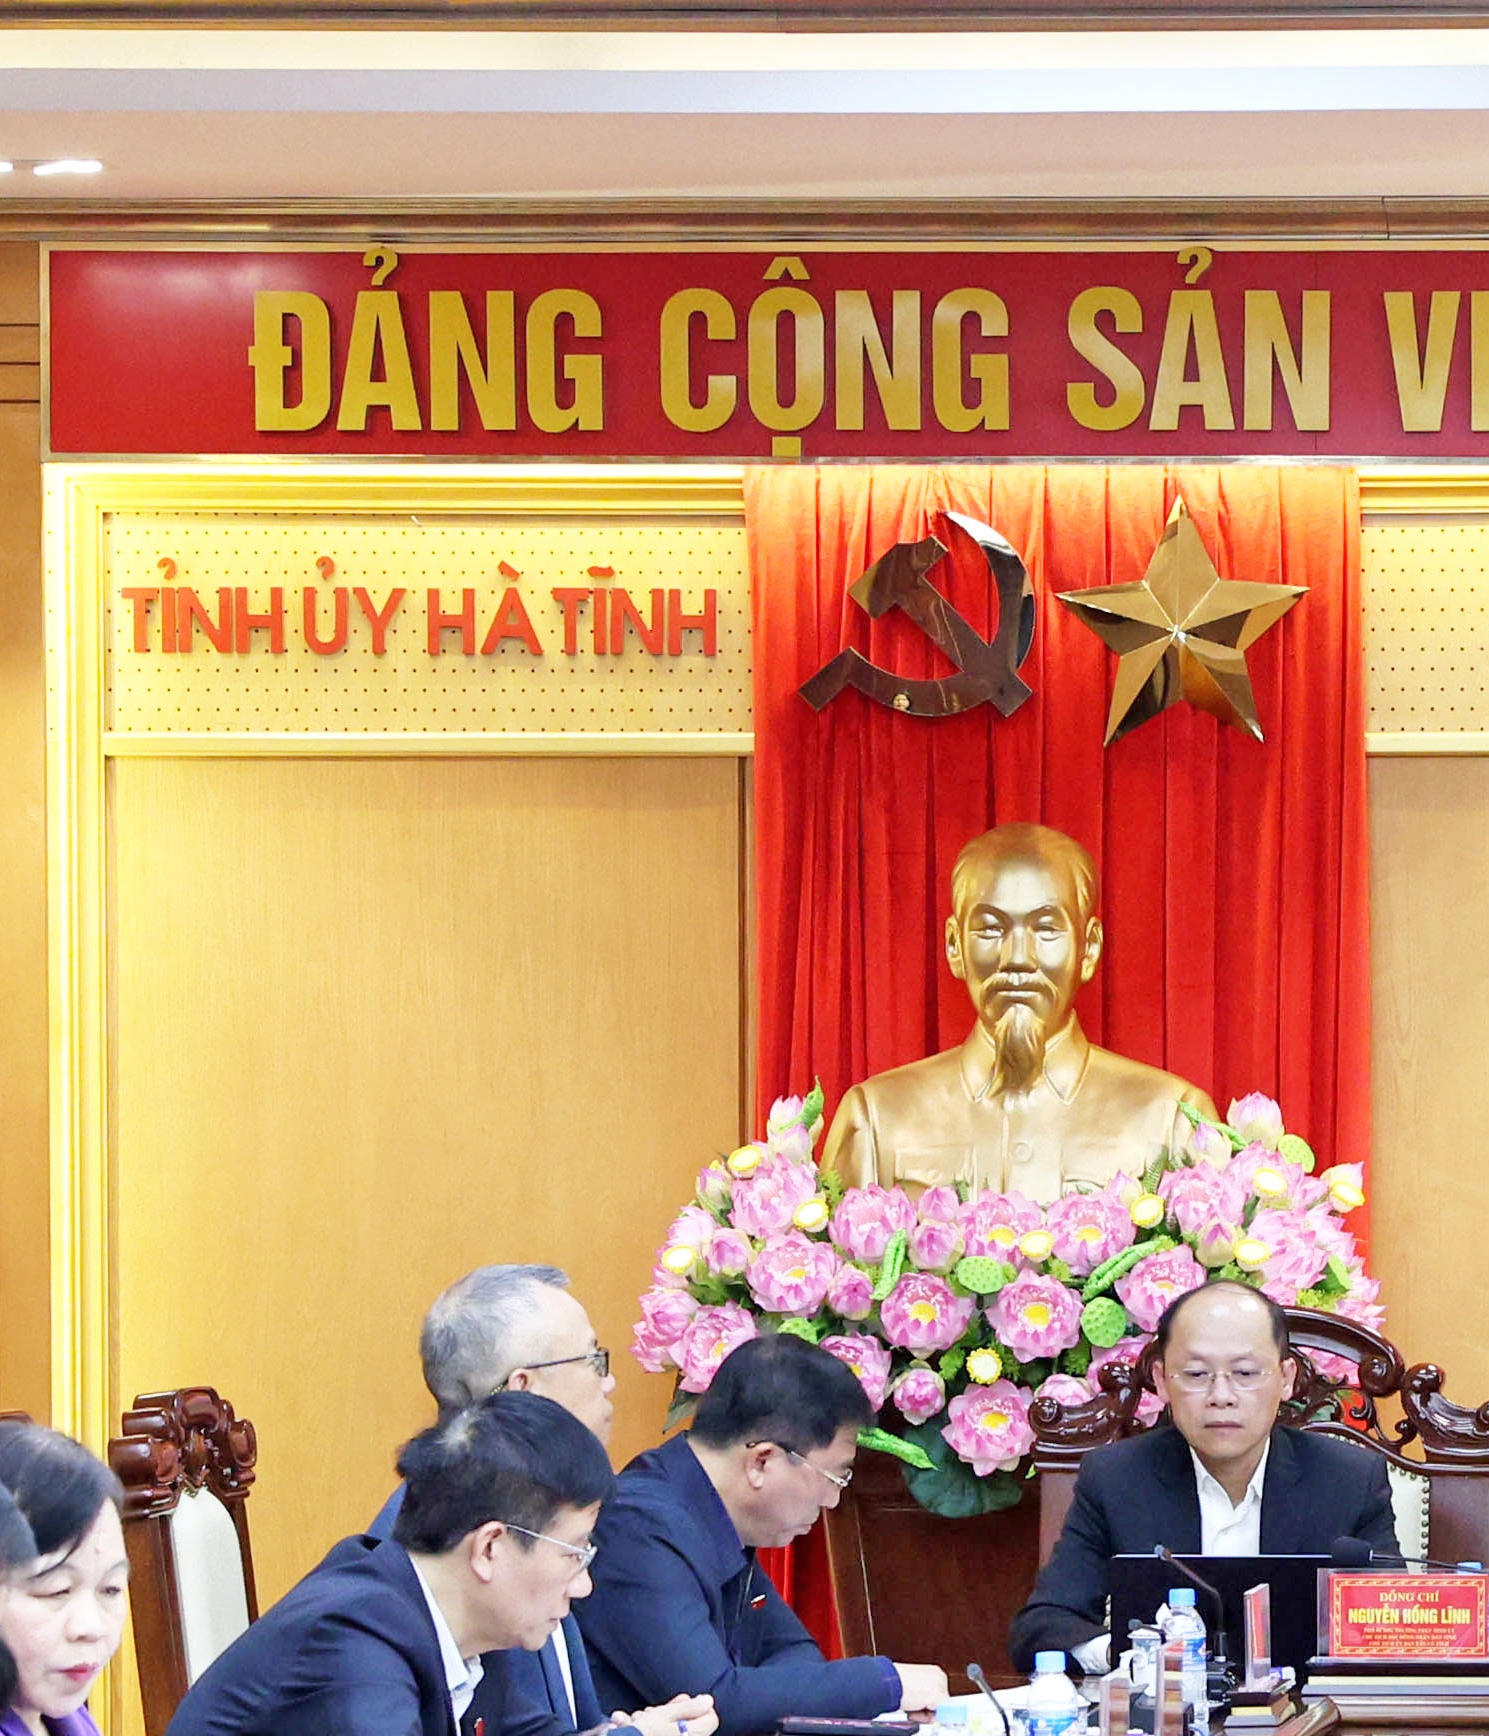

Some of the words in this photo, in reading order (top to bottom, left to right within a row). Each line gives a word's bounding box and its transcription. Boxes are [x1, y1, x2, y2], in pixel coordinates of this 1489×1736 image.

[248, 246, 604, 433] ĐẢNG
[659, 256, 1011, 457] CỘNG
[1066, 246, 1332, 432] SẢN
[121, 557, 285, 655] TỈNH
[303, 556, 407, 656] ỦY
[426, 560, 544, 657] HÀ
[552, 565, 718, 658] TĨNH
[1348, 1603, 1400, 1625] NGUYỄN
[1441, 1605, 1471, 1625] LĨNH
[1418, 1590, 1440, 1603] CHÍ
